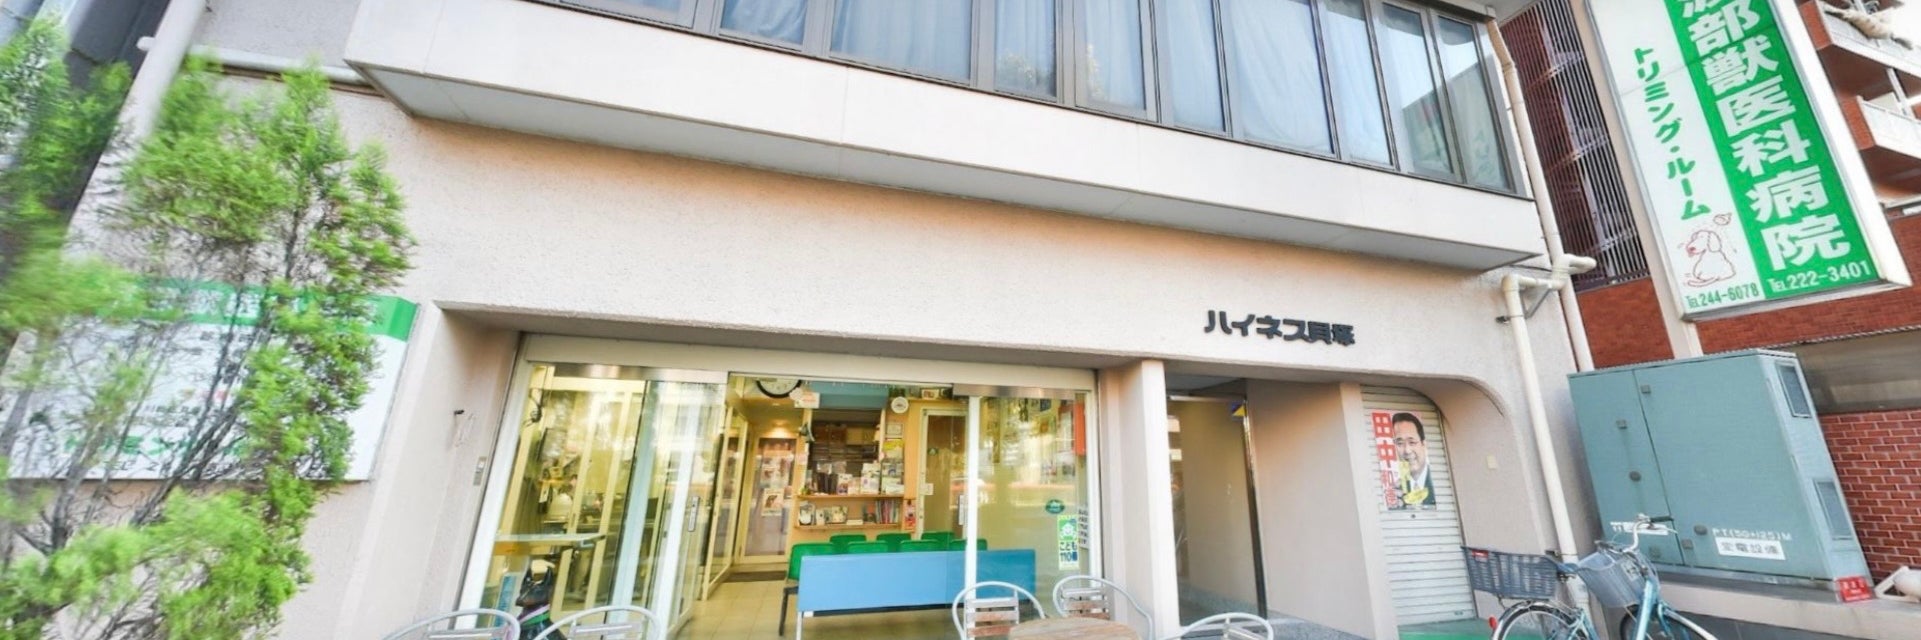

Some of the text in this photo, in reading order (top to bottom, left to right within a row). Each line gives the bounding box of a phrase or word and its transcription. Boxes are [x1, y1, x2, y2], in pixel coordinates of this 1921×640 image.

[1634, 47, 1711, 220] トリミング・ルーム
[1786, 260, 1871, 289] 222-3401
[1700, 282, 1760, 307] 244-6078
[1204, 309, 1356, 347] ハイネス貝塚
